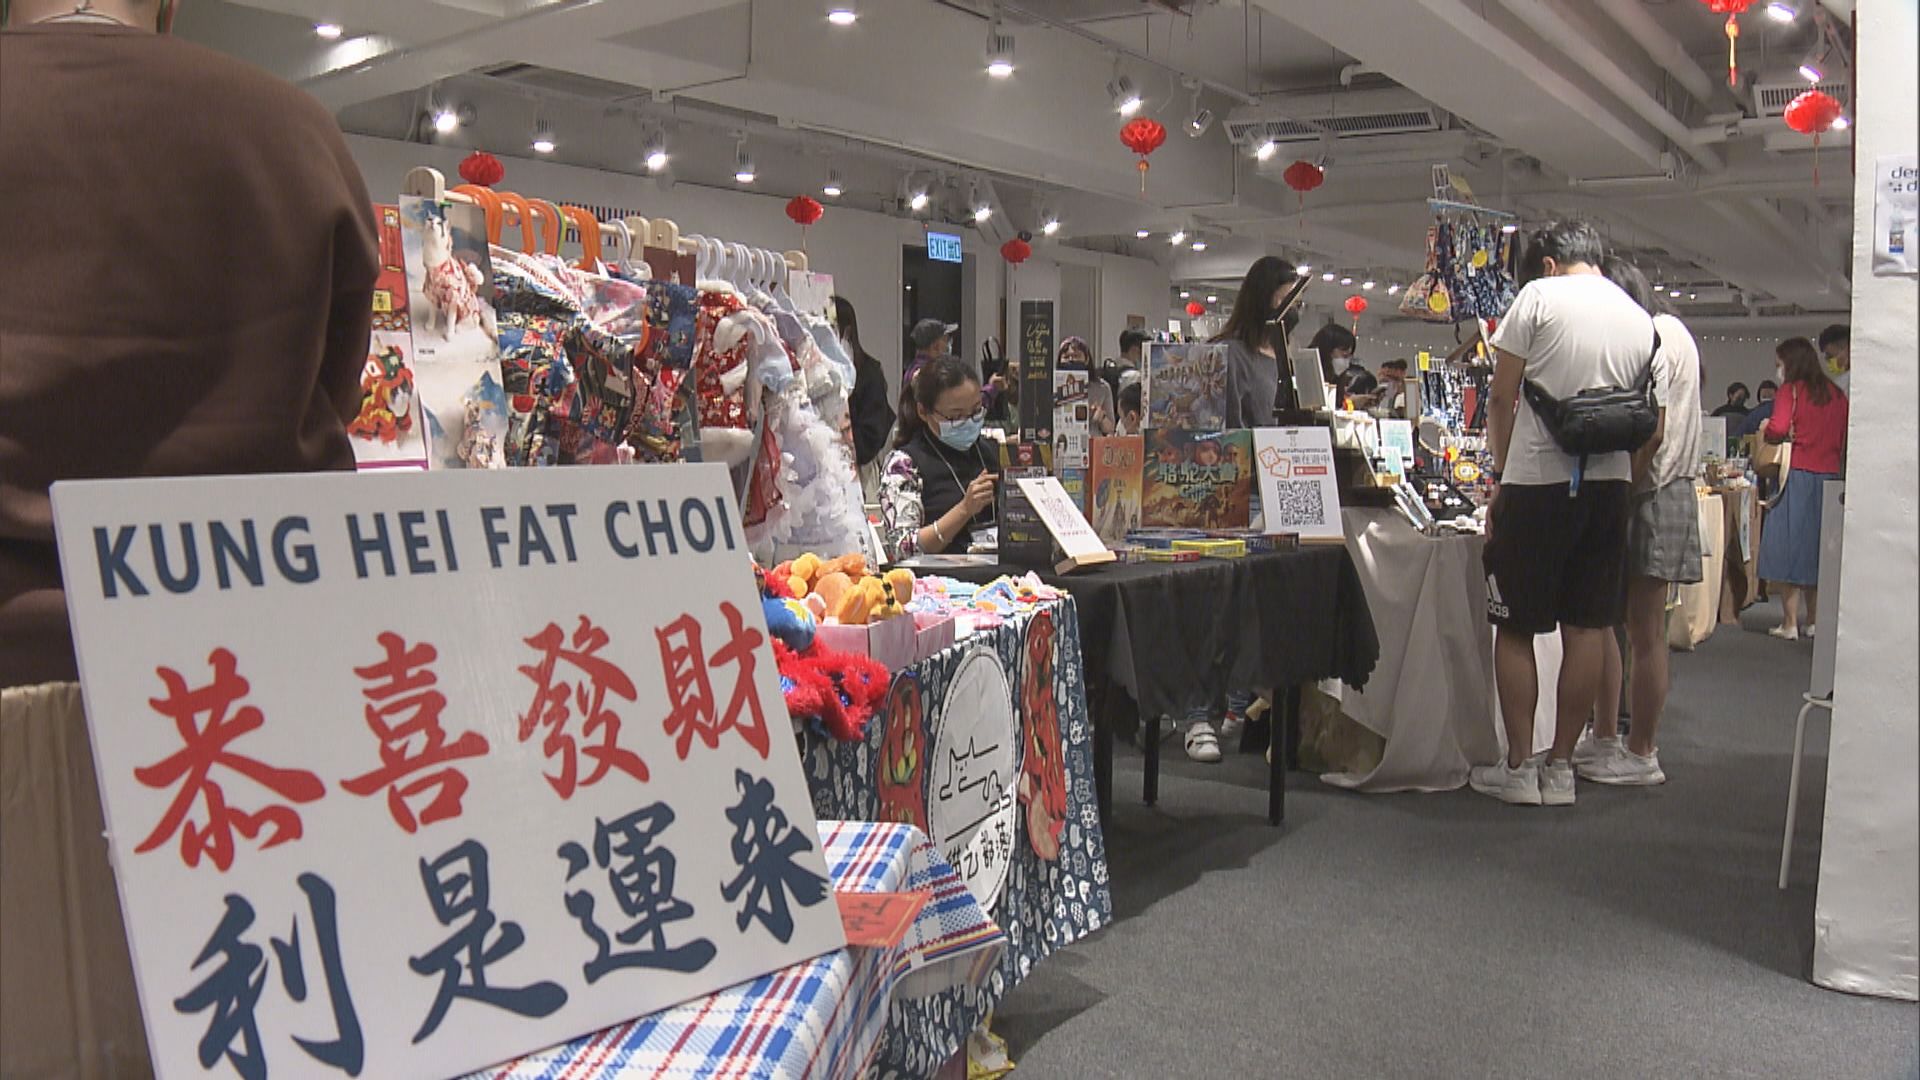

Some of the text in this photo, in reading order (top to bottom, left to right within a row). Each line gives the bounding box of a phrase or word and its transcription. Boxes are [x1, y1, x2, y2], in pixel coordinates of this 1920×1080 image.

[929, 238, 946, 258] EXIT
[947, 240, 961, 259] 出口
[94, 497, 734, 598] KUNG HEI FAT CHOI
[135, 603, 769, 871] 恭喜發財
